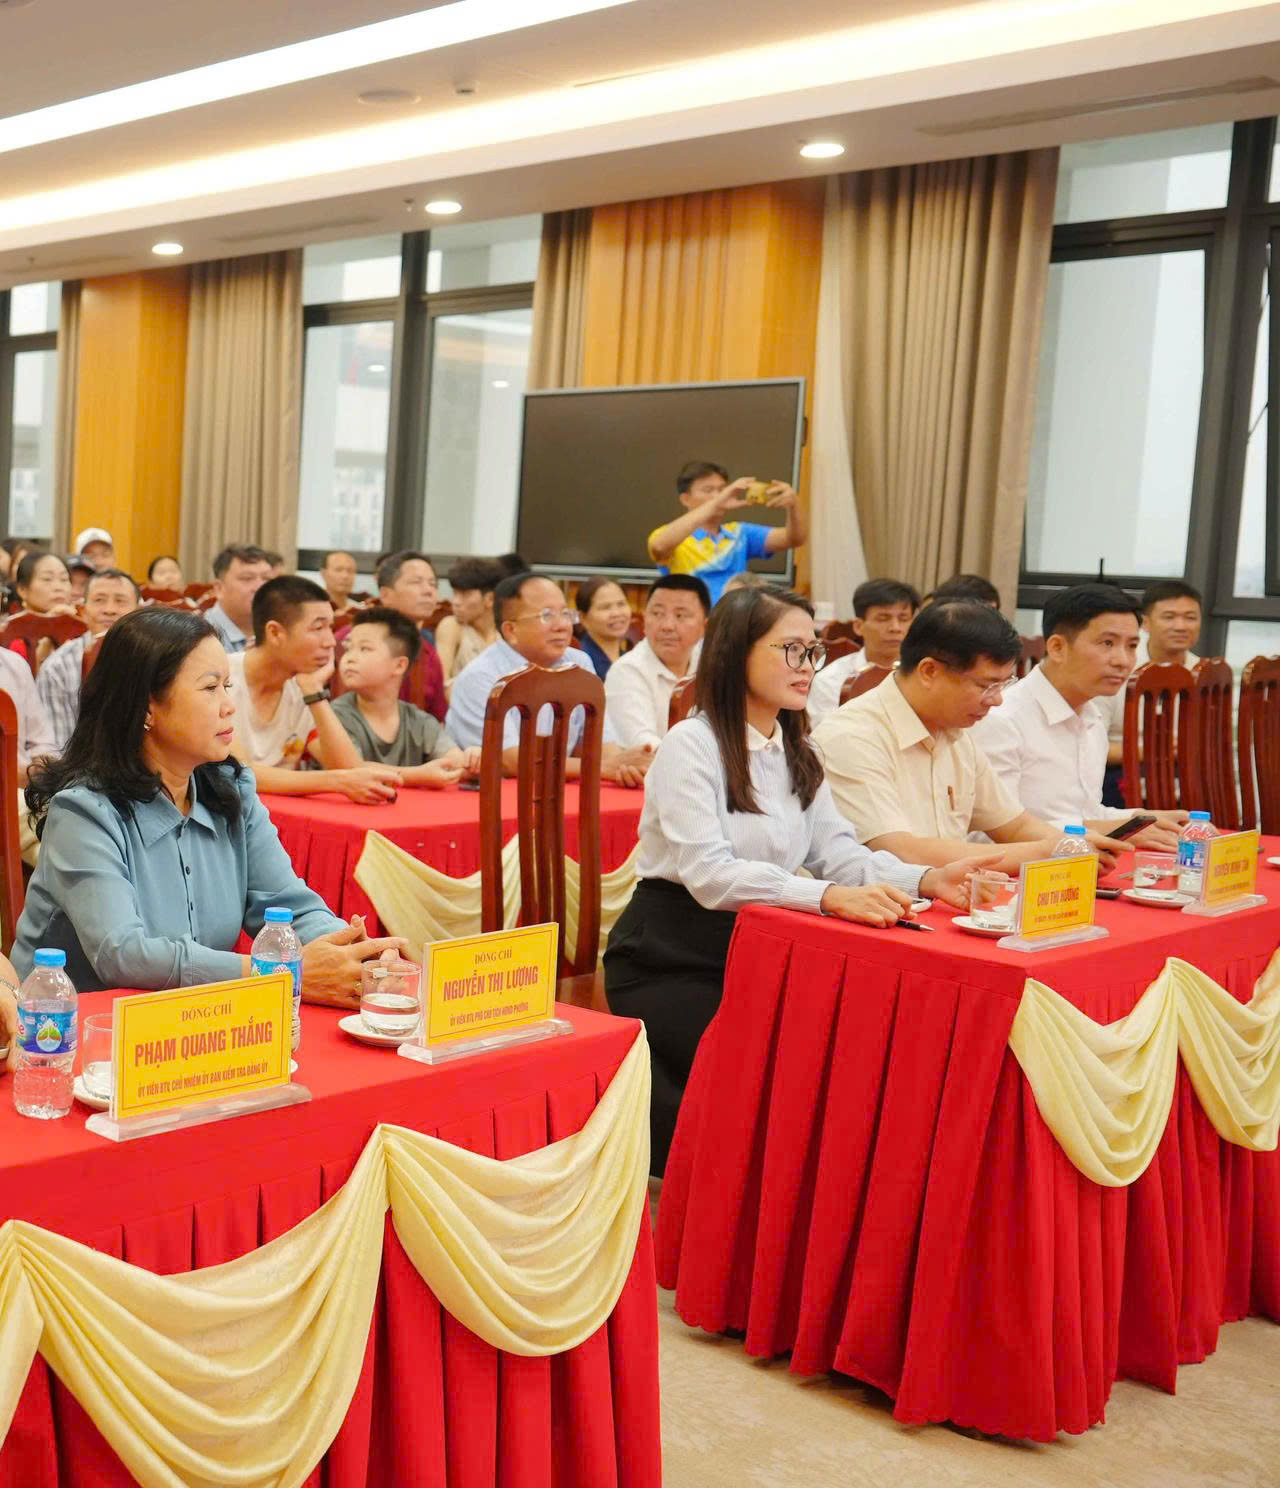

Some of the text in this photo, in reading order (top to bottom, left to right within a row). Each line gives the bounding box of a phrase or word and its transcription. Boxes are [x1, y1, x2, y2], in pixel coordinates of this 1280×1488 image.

[474, 947, 513, 965] ĐỒNG CHÍ
[443, 965, 539, 1001] NGUYỄN THỊ LƯỢNG
[181, 999, 232, 1021] ĐỒNG CHÍ
[135, 1015, 273, 1068] PHẠM QUANG THẮNG
